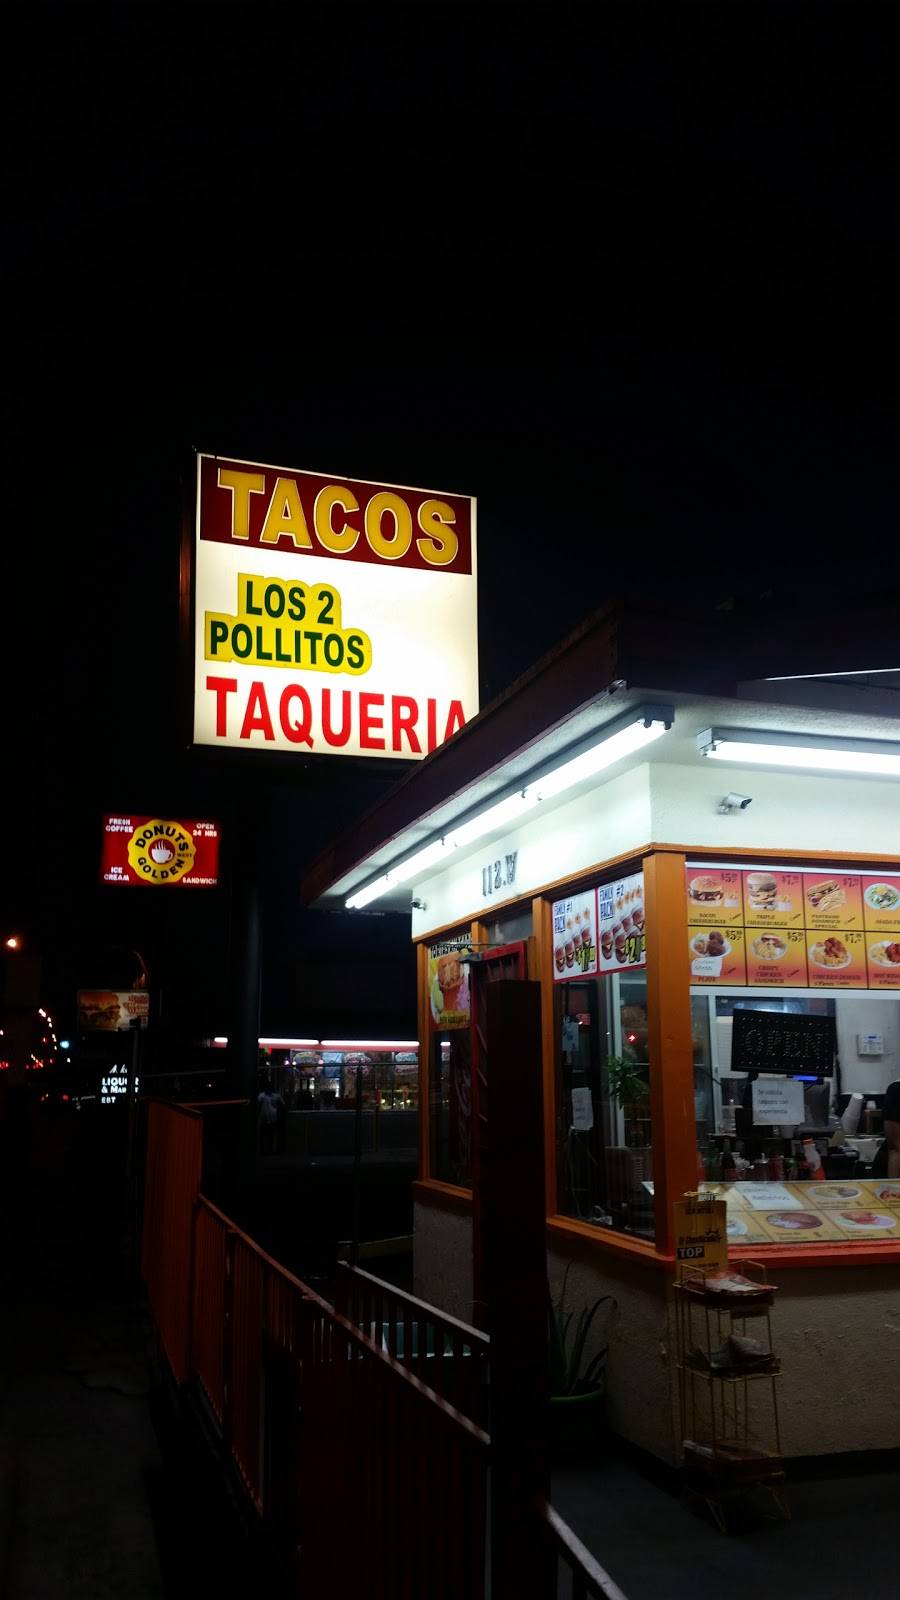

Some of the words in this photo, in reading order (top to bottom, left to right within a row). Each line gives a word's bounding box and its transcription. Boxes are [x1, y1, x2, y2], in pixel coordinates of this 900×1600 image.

[217, 467, 459, 566] TACOS
[246, 580, 306, 621] LOS
[317, 590, 335, 625] 2
[210, 620, 364, 669] POLLITOS
[206, 675, 467, 753] TAQUERIA
[105, 825, 133, 833] COFFEE
[135, 825, 189, 852] DONUTS
[110, 866, 123, 874] ICE
[137, 857, 185, 879] GOLDEN
[103, 873, 130, 881] CREAM
[182, 877, 217, 885] SANDWICH
[102, 1077, 140, 1086] LIQUR
[101, 1086, 108, 1094] &
[679, 1247, 703, 1258] TOP
